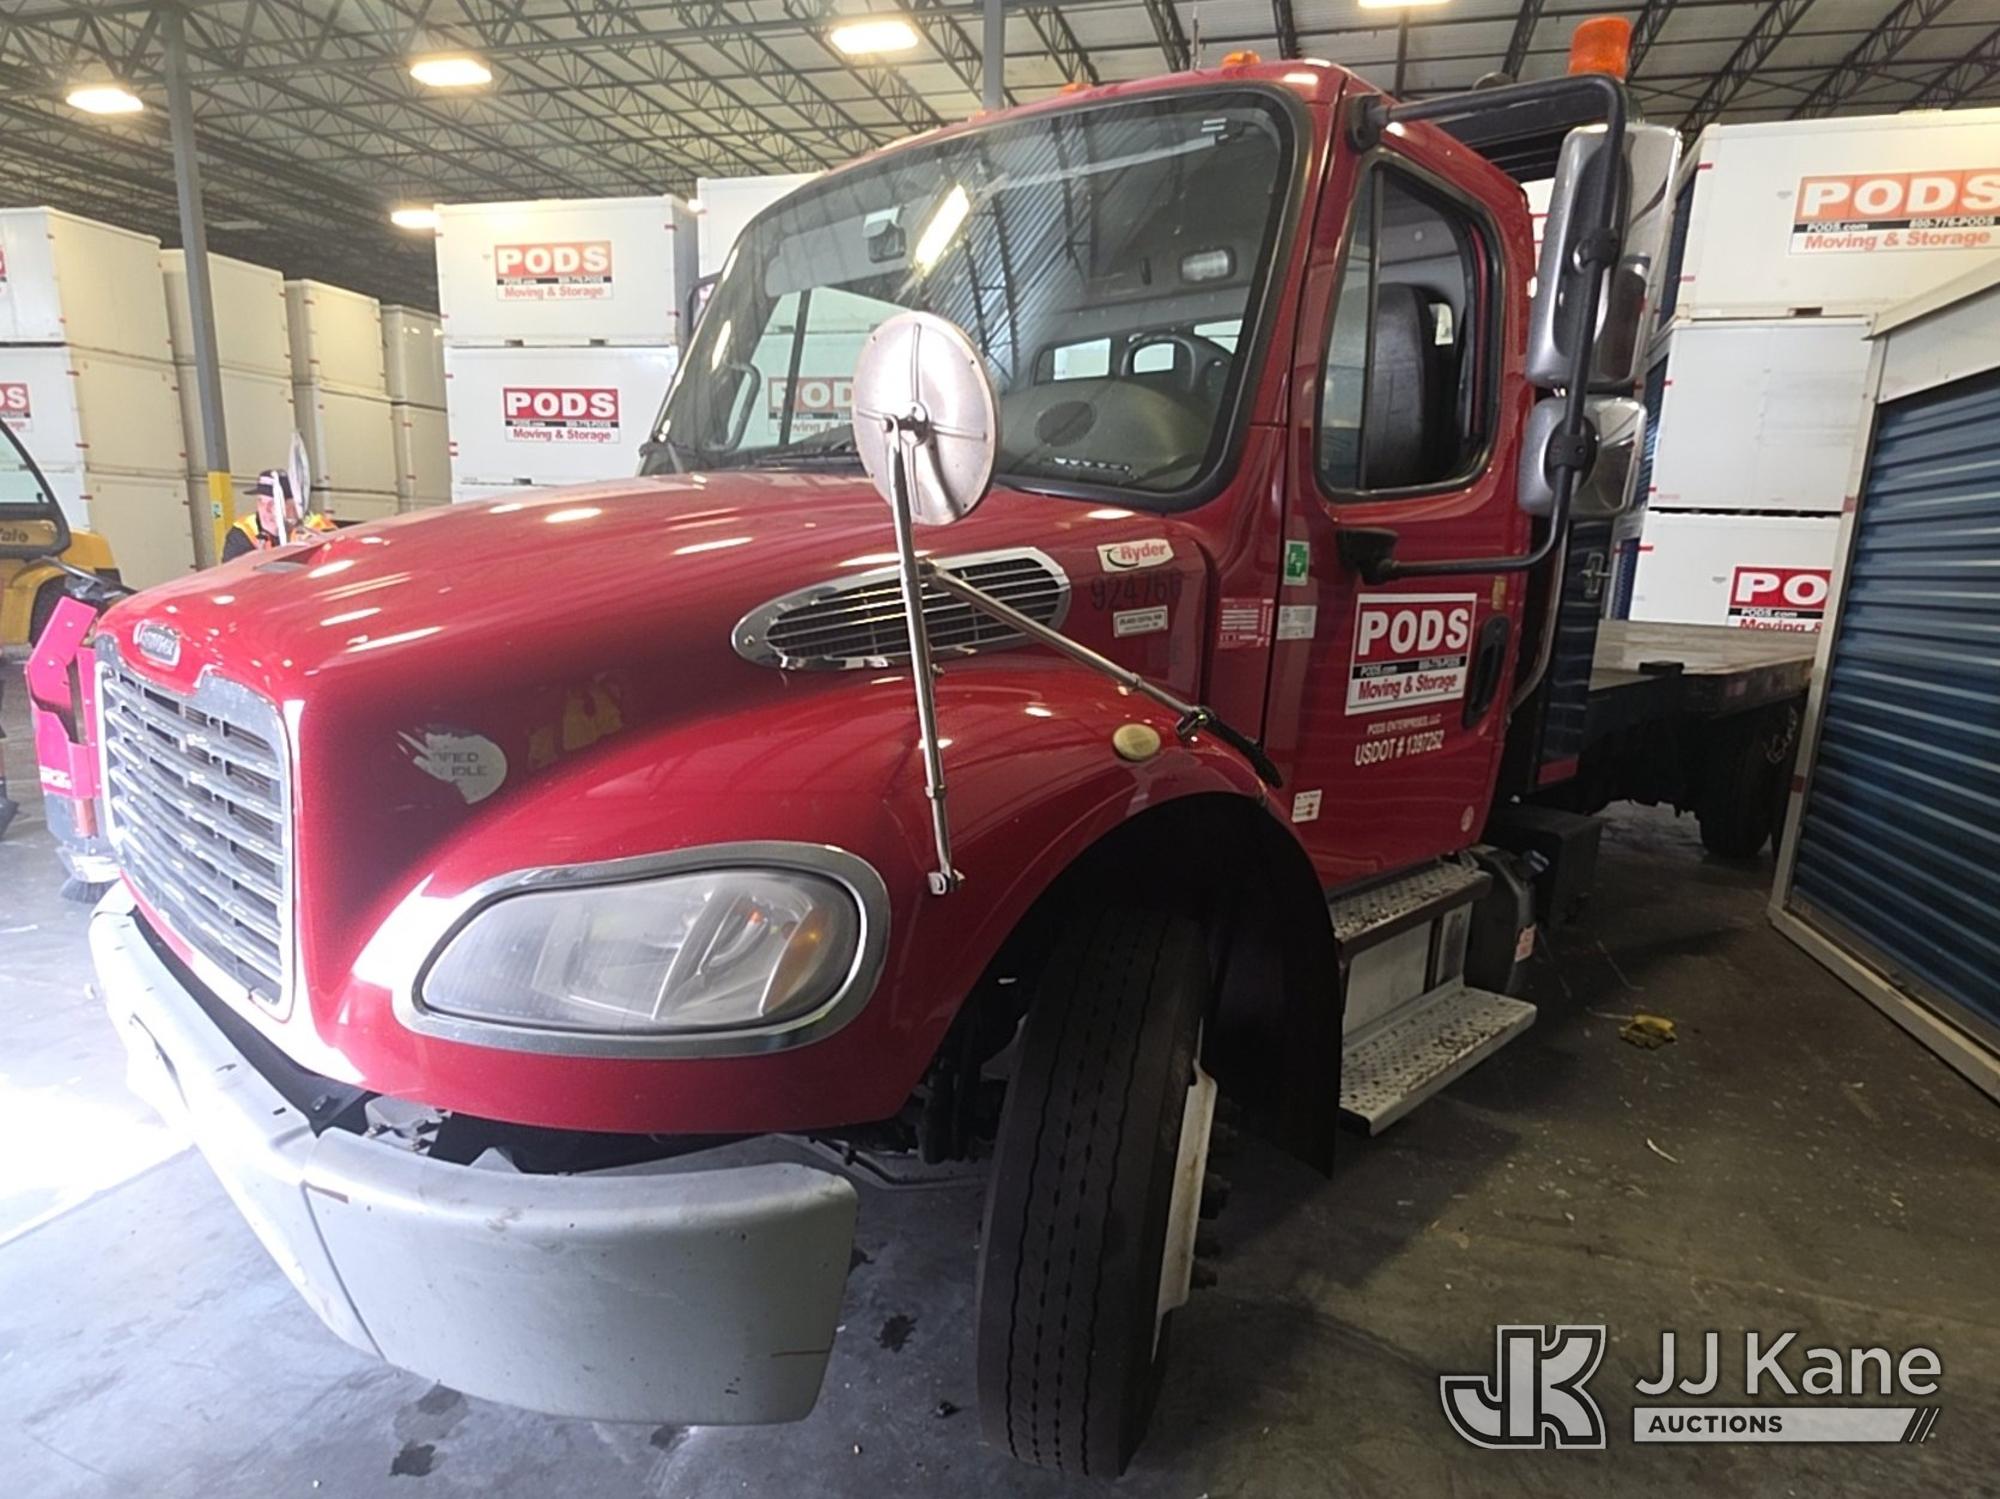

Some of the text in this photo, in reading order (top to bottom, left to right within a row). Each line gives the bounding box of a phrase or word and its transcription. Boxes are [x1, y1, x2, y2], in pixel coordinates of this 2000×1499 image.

[1802, 174, 2000, 217] PODS
[1804, 230, 1991, 251] Moving & Storage
[496, 246, 609, 274] PODS
[505, 286, 604, 300] Moving & Storage
[506, 391, 616, 418] PODS
[771, 381, 853, 408] POD
[513, 428, 611, 442] Moving & Storage
[1120, 543, 1167, 561] Ryder
[1735, 572, 1828, 605] PO
[1358, 608, 1469, 656] PODS
[1358, 674, 1457, 700] Moving & Storage
[1355, 738, 1397, 766] USDOT
[1396, 735, 1406, 759] #
